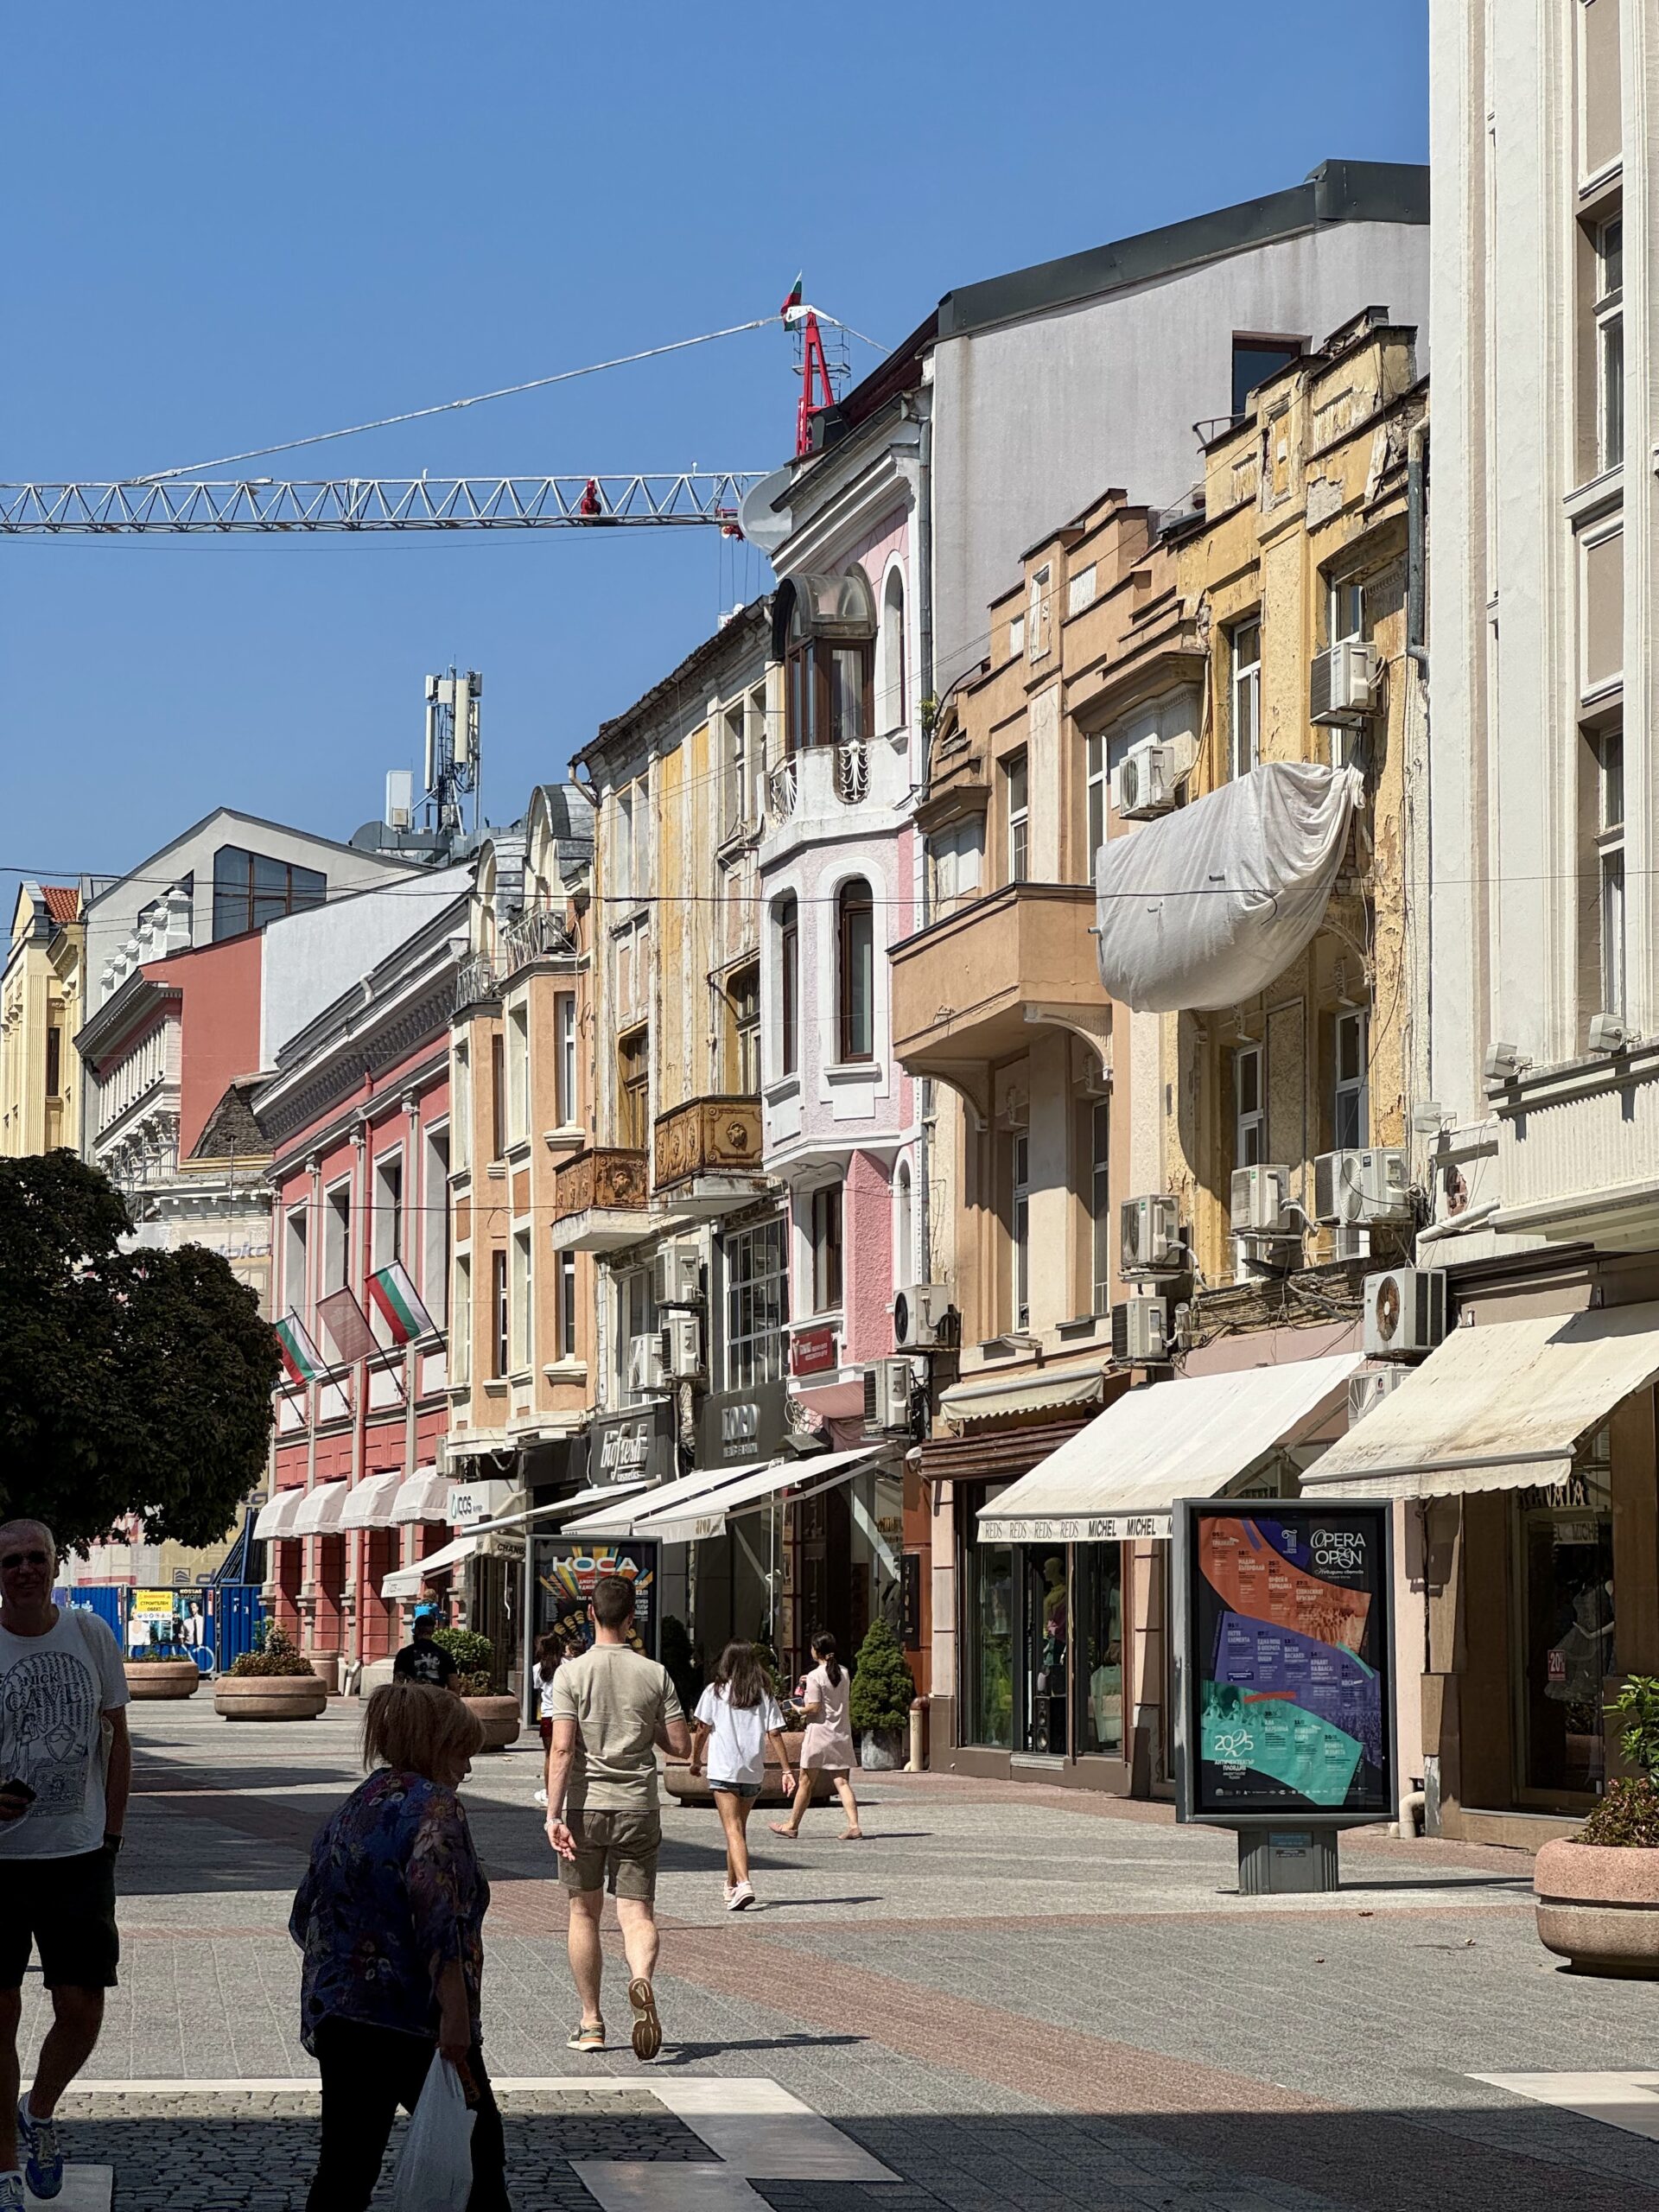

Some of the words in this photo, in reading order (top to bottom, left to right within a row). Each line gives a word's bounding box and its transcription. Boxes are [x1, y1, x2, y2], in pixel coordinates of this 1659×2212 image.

[985, 1522, 1002, 1539] REDS
[1009, 1522, 1027, 1539] REDS
[1034, 1522, 1052, 1539] REDS
[1060, 1521, 1079, 1539] REDS
[1088, 1520, 1116, 1537] MICHEL
[1126, 1518, 1156, 1535] MICHEL
[1310, 1529, 1366, 1548] OPERA
[497, 1543, 525, 1554] CHANG
[1315, 1547, 1363, 1568] OPEN
[22, 1673, 59, 1687] NICK
[5, 1681, 82, 1713] CAVE
[1214, 1728, 1254, 1758] 2025
